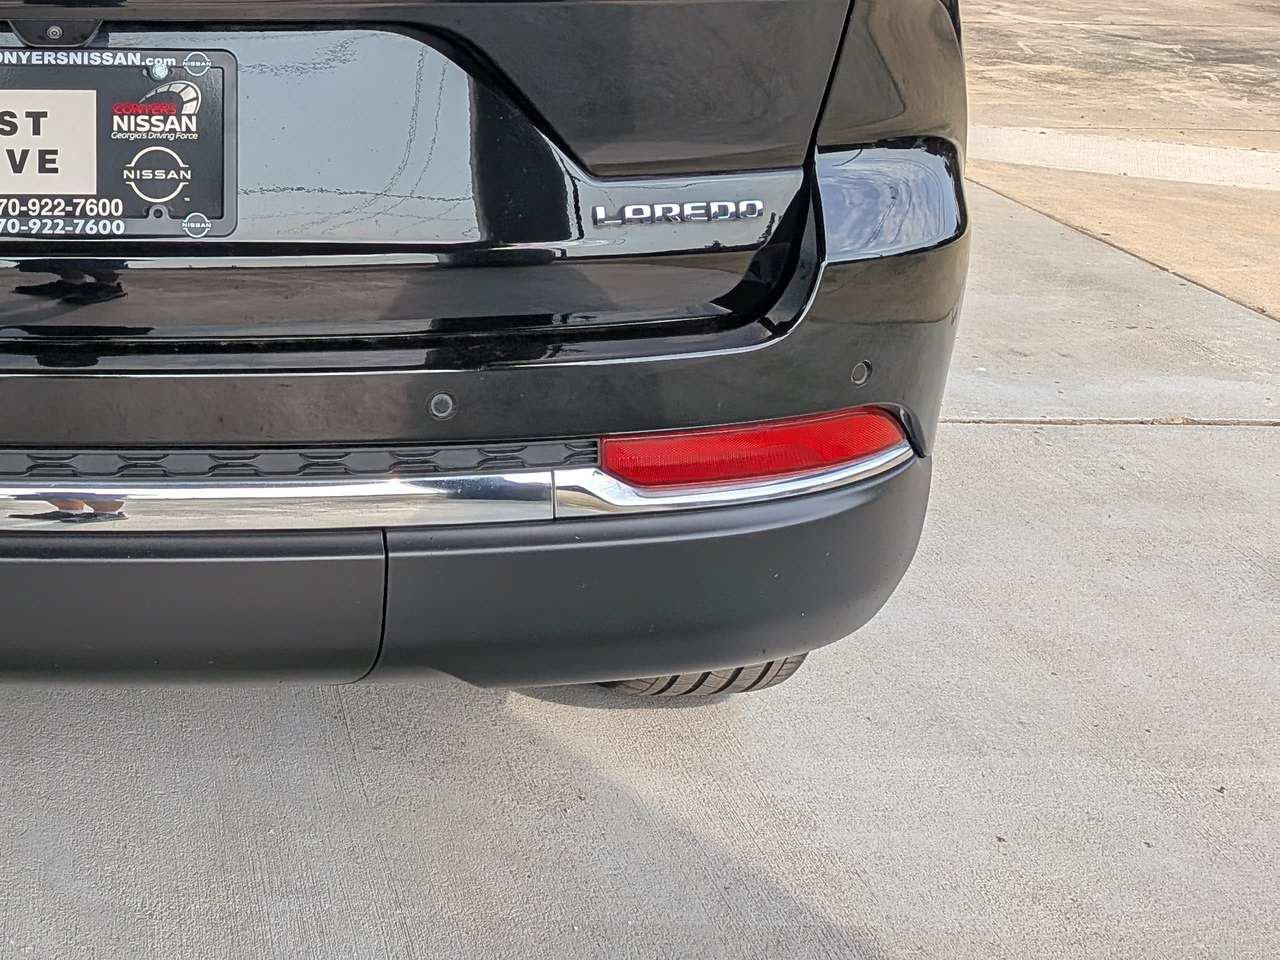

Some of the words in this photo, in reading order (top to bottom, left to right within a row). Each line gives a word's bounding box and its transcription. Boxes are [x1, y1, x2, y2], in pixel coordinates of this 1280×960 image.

[112, 114, 197, 132] NISSAN
[111, 131, 147, 140] Georgia's
[148, 131, 175, 140] Driving
[176, 132, 198, 140] Force
[123, 169, 192, 180] NISSAN
